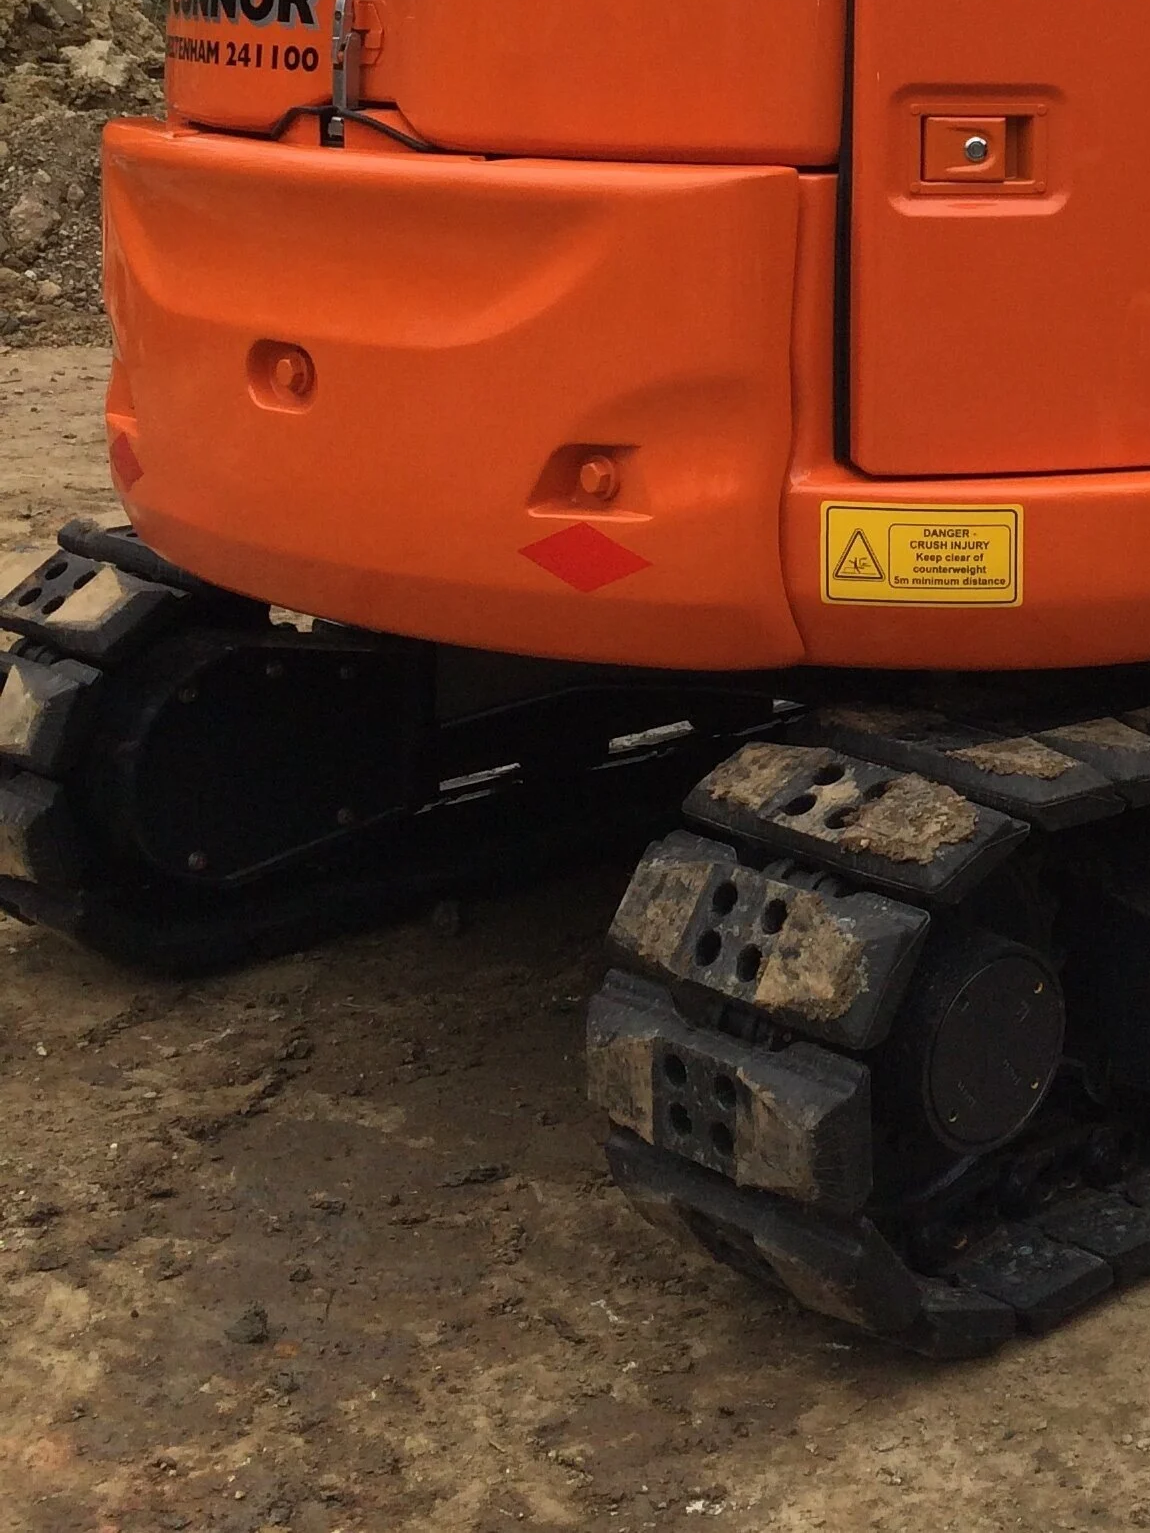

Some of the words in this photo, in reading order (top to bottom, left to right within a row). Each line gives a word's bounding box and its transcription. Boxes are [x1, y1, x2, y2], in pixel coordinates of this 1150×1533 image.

[226, 41, 320, 72] 241100
[923, 528, 970, 538] DANGER
[909, 540, 948, 550] CRUSH
[950, 540, 990, 550] INJURY
[916, 552, 942, 564] Keep
[945, 553, 971, 562] clear
[973, 552, 985, 562] of
[912, 564, 987, 576] counterweight
[894, 575, 909, 585] 5m
[912, 575, 960, 586] minimum
[962, 576, 1007, 586] distance
